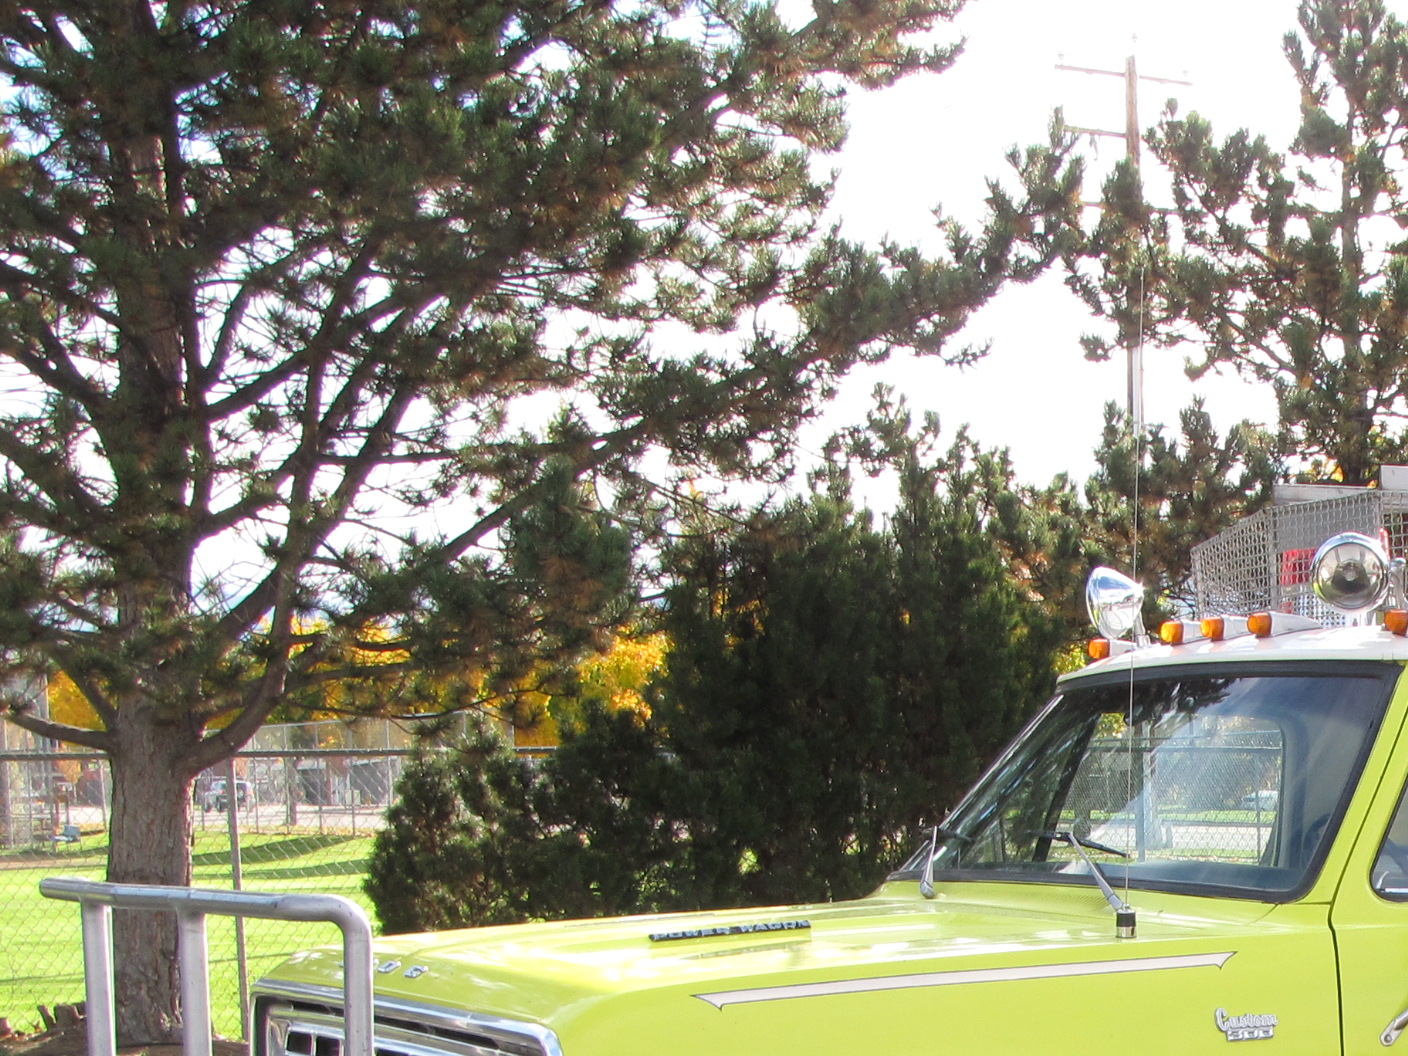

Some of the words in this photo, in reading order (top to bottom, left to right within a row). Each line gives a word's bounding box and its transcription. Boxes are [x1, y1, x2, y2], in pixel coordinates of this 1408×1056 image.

[653, 926, 730, 941] POWER
[740, 920, 811, 934] WAGON
[1215, 1007, 1279, 1032] Custom
